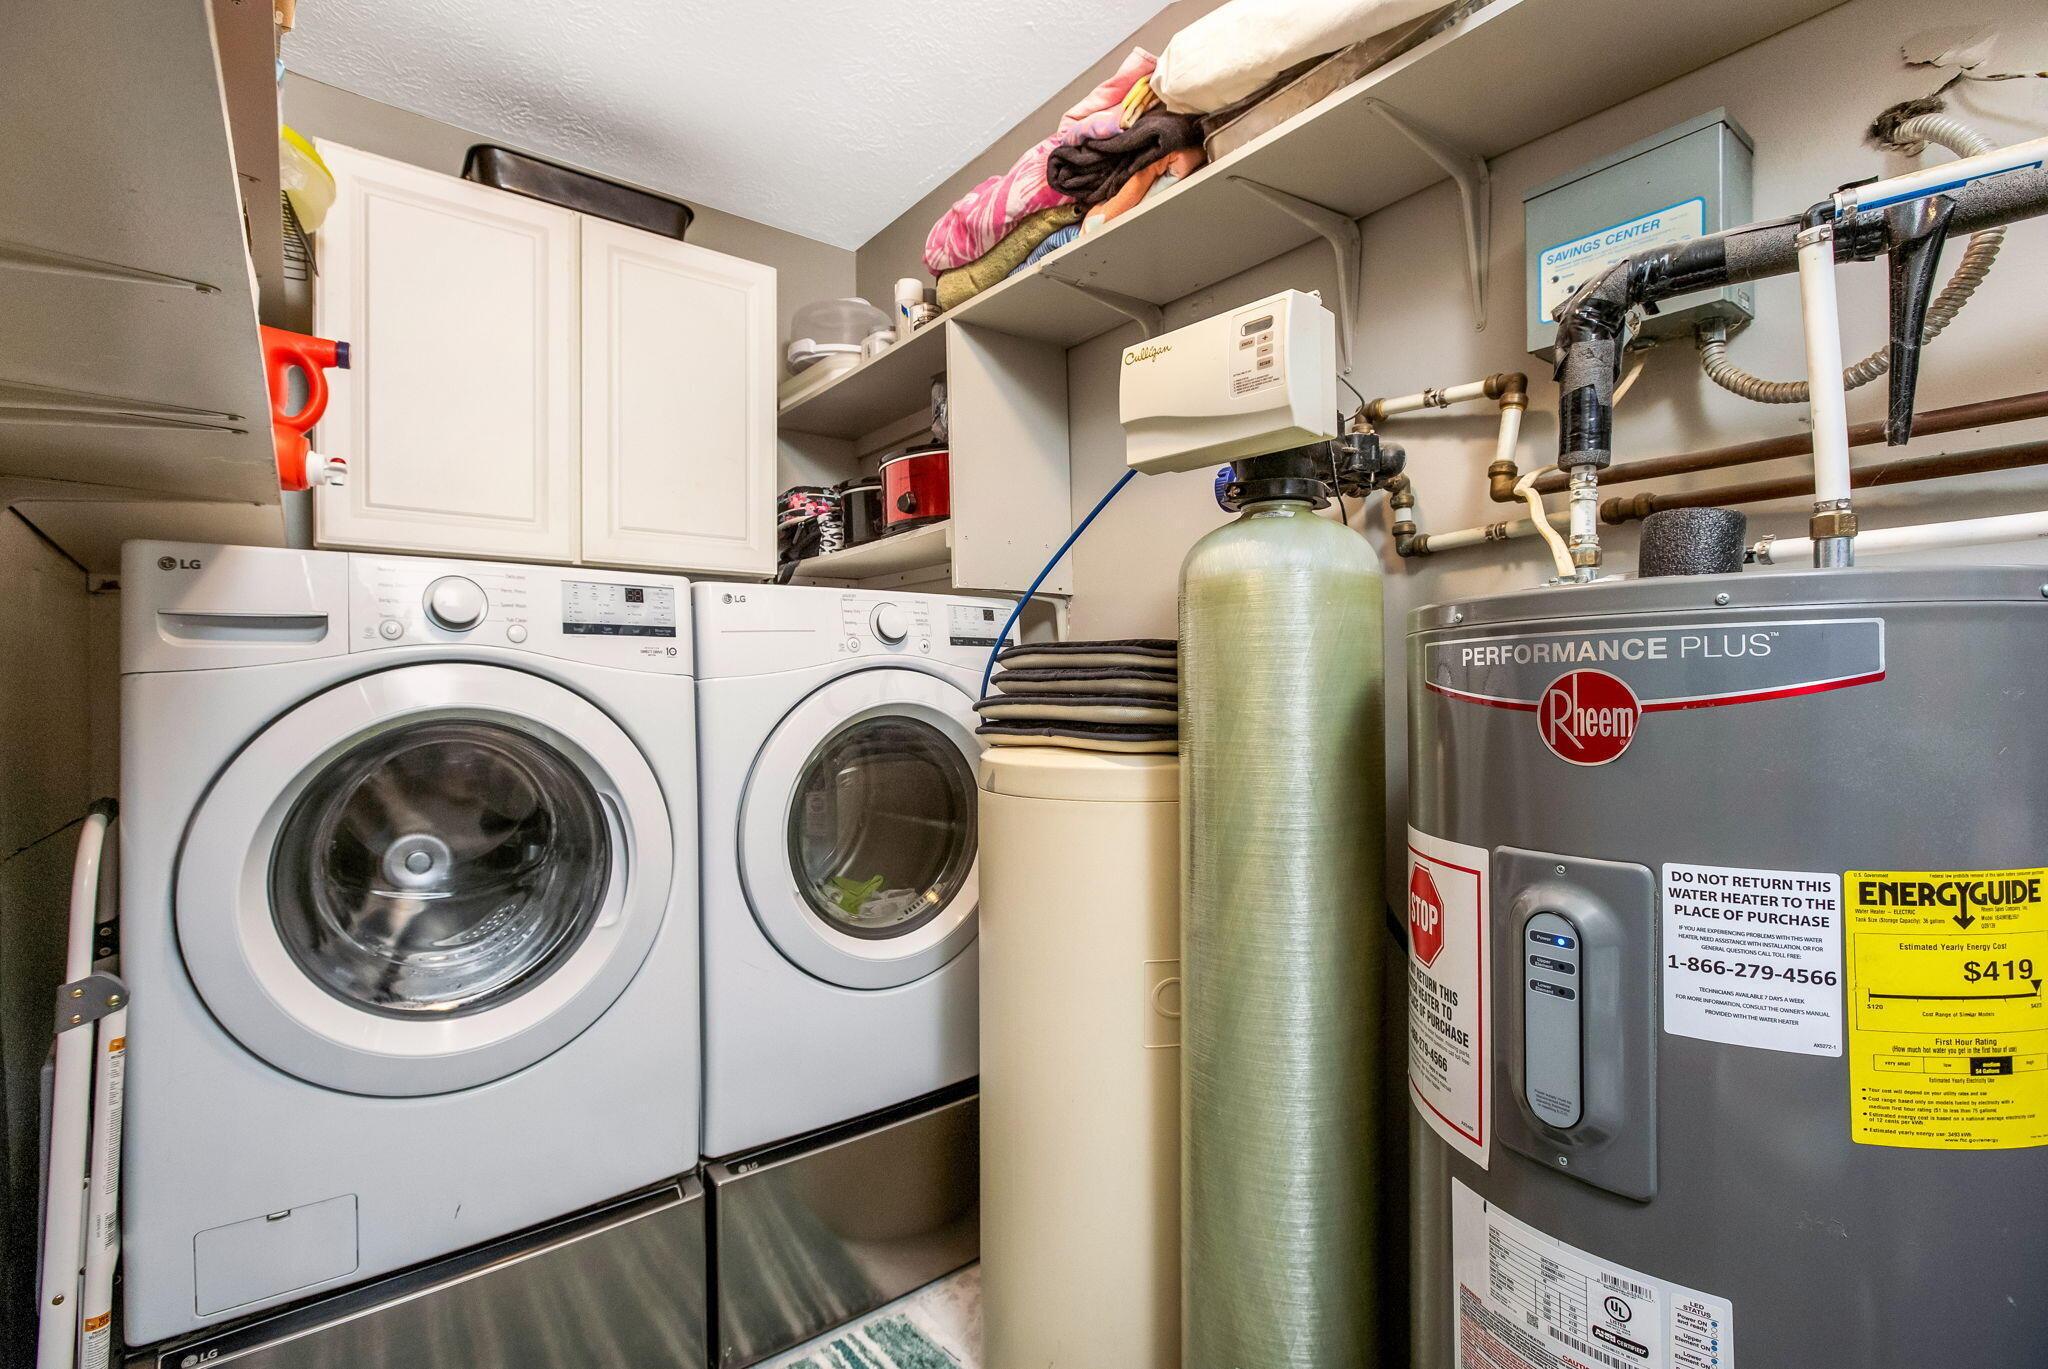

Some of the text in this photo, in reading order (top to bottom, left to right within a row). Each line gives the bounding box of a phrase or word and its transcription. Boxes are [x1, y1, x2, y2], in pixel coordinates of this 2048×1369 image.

[1547, 239, 1600, 265] SAVINGS
[1605, 219, 1661, 245] CENTER
[1125, 345, 1172, 366] Culligan
[180, 559, 201, 569] LG
[734, 595, 746, 603] LG
[1462, 637, 1668, 667] PERFORMANCE
[1550, 673, 1634, 750] Rheem
[1672, 871, 1831, 892] DO NOT RETURN THIS
[1669, 887, 1836, 910] WATER HEATER TO THE
[1859, 879, 2041, 906] ENERGYGUIDE
[1411, 892, 1438, 936] STOP
[1674, 905, 1830, 927] PLACE OF PURCHASE
[1708, 927, 1745, 936] EXPERIENCING
[1746, 931, 1775, 939] PROBLEMS
[1715, 937, 1746, 945] ASSISTANCE
[1899, 942, 2007, 951] Estimated Yearly Energy Cost
[1726, 947, 1757, 955] QUESTIONS
[1535, 961, 1554, 969] Element
[1668, 954, 1837, 986] 1-866-279-4566
[1964, 958, 2033, 984] $419
[1416, 970, 1436, 996] RETURN
[1440, 984, 1458, 1006] THIS
[1535, 986, 1554, 994] Element
[1699, 987, 1734, 996] TECHNICIANS
[1735, 991, 1763, 999] AVAILABLE
[1418, 986, 1452, 1022] HEATER TO
[1742, 1002, 1767, 1010] CONSULT
[1780, 1006, 1804, 1014] OWNER'S
[1806, 1009, 1830, 1017] MANUAL
[1705, 1009, 1732, 1017] PROVIDED
[1778, 1017, 1799, 1025] HEATER
[1420, 1003, 1469, 1048] OF PURCHASE
[1975, 1038, 1997, 1046] Rating
[748, 1162, 758, 1170] LG
[1682, 1304, 1711, 1318] STATUS
[1690, 1301, 1704, 1310] LED
[1677, 1312, 1707, 1327] Power ON
[1677, 1319, 1707, 1333] and ready
[1675, 1335, 1711, 1352] Element ON
[1684, 1333, 1702, 1344] Upper
[200, 1348, 218, 1362] LG
[1675, 1354, 1699, 1367] Element
[1683, 1351, 1702, 1362] Lower
